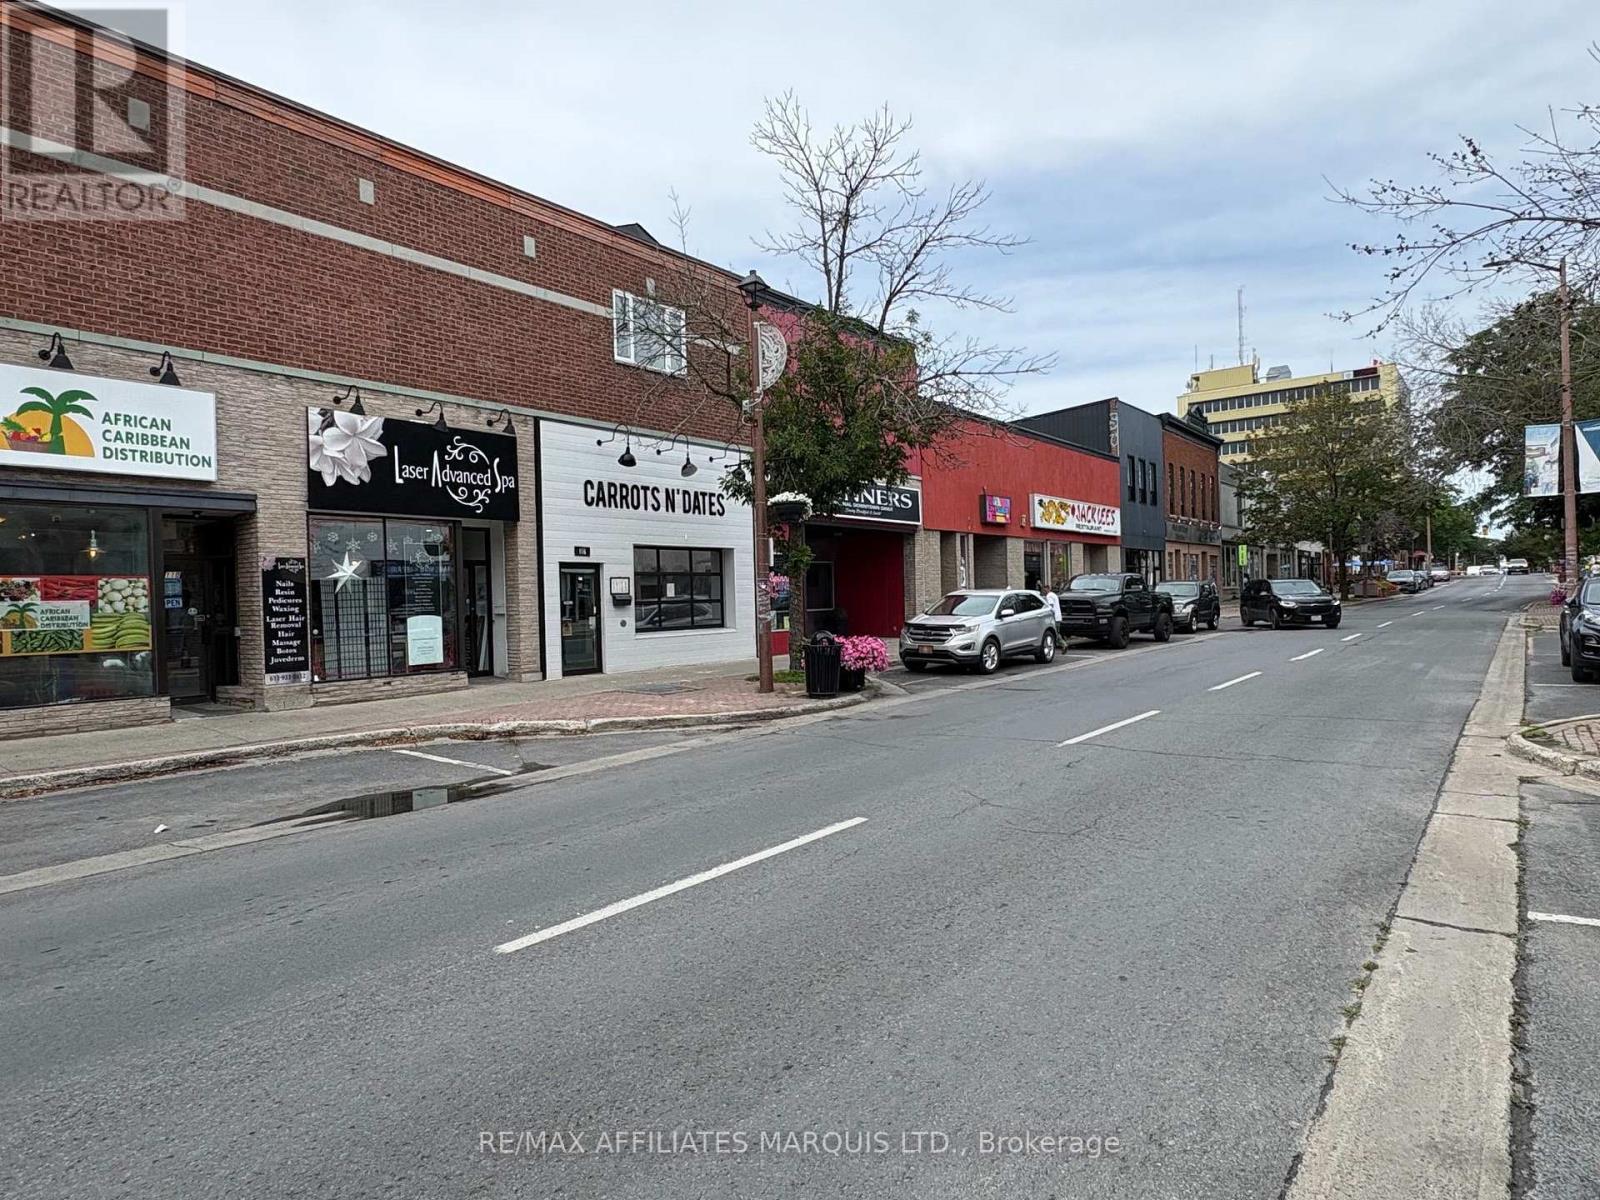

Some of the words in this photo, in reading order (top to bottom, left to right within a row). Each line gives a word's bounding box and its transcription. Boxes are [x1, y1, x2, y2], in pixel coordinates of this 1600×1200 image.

[101, 411, 171, 432] AFRICAN
[102, 430, 190, 450] CARIBBEAN
[103, 446, 212, 468] DISTRIBUTION
[394, 445, 429, 484] Laser
[431, 450, 491, 487] Advanced
[494, 457, 515, 494] Spa
[583, 479, 661, 512] CARROTS
[272, 605, 299, 613] Waxing
[271, 621, 301, 629] Removal
